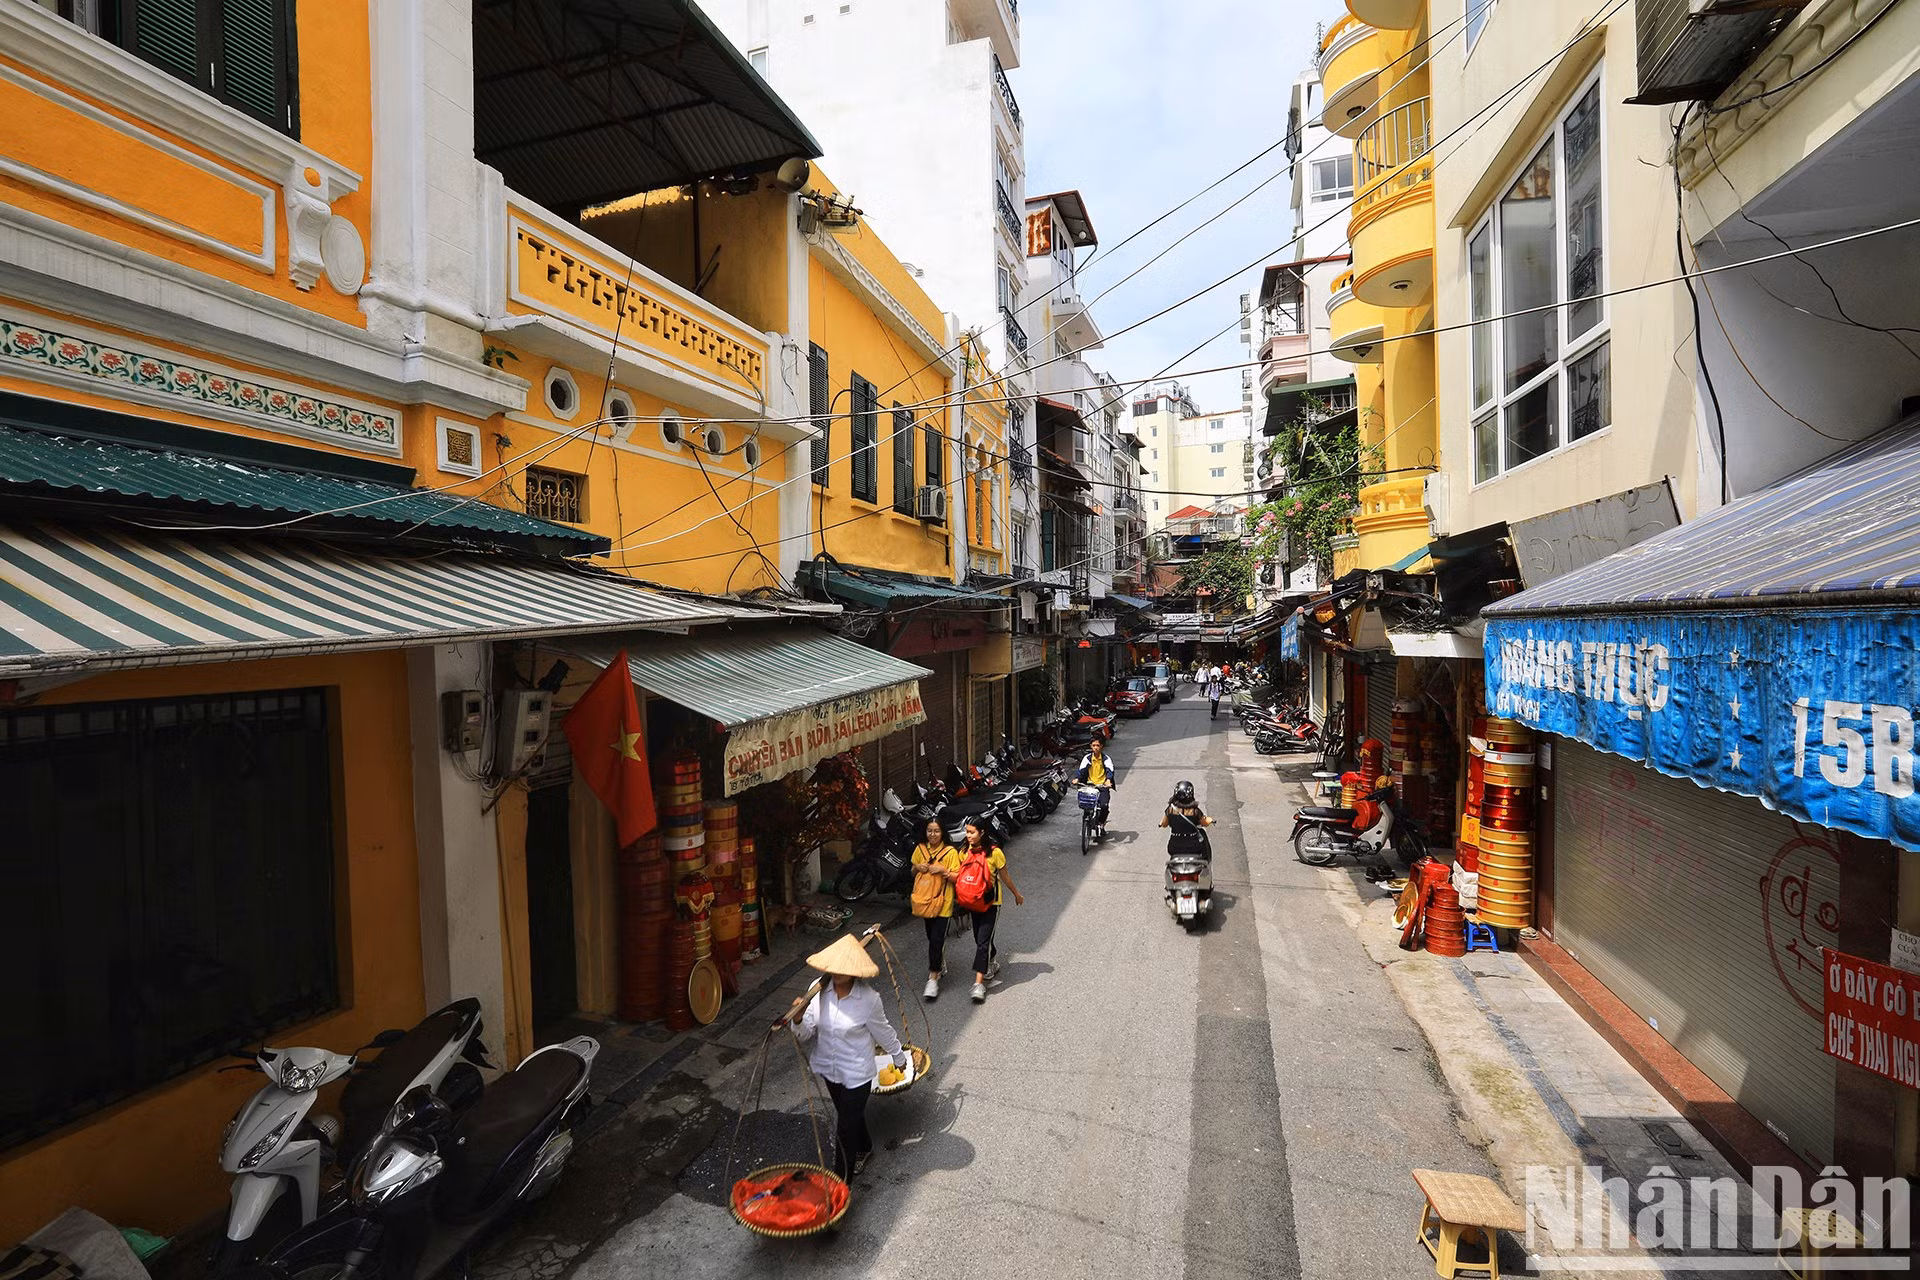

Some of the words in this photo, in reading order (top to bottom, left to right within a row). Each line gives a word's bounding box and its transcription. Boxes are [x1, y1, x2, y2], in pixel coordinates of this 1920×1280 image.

[1581, 636, 1671, 721] THỰC
[779, 731, 804, 762] BÁN
[1791, 696, 1915, 799] 15B
[1844, 966, 1878, 1007] ĐÂY
[1883, 980, 1907, 1017] CÓ
[1828, 1009, 1855, 1061] CHÈ
[1858, 1021, 1889, 1076] THÁI
